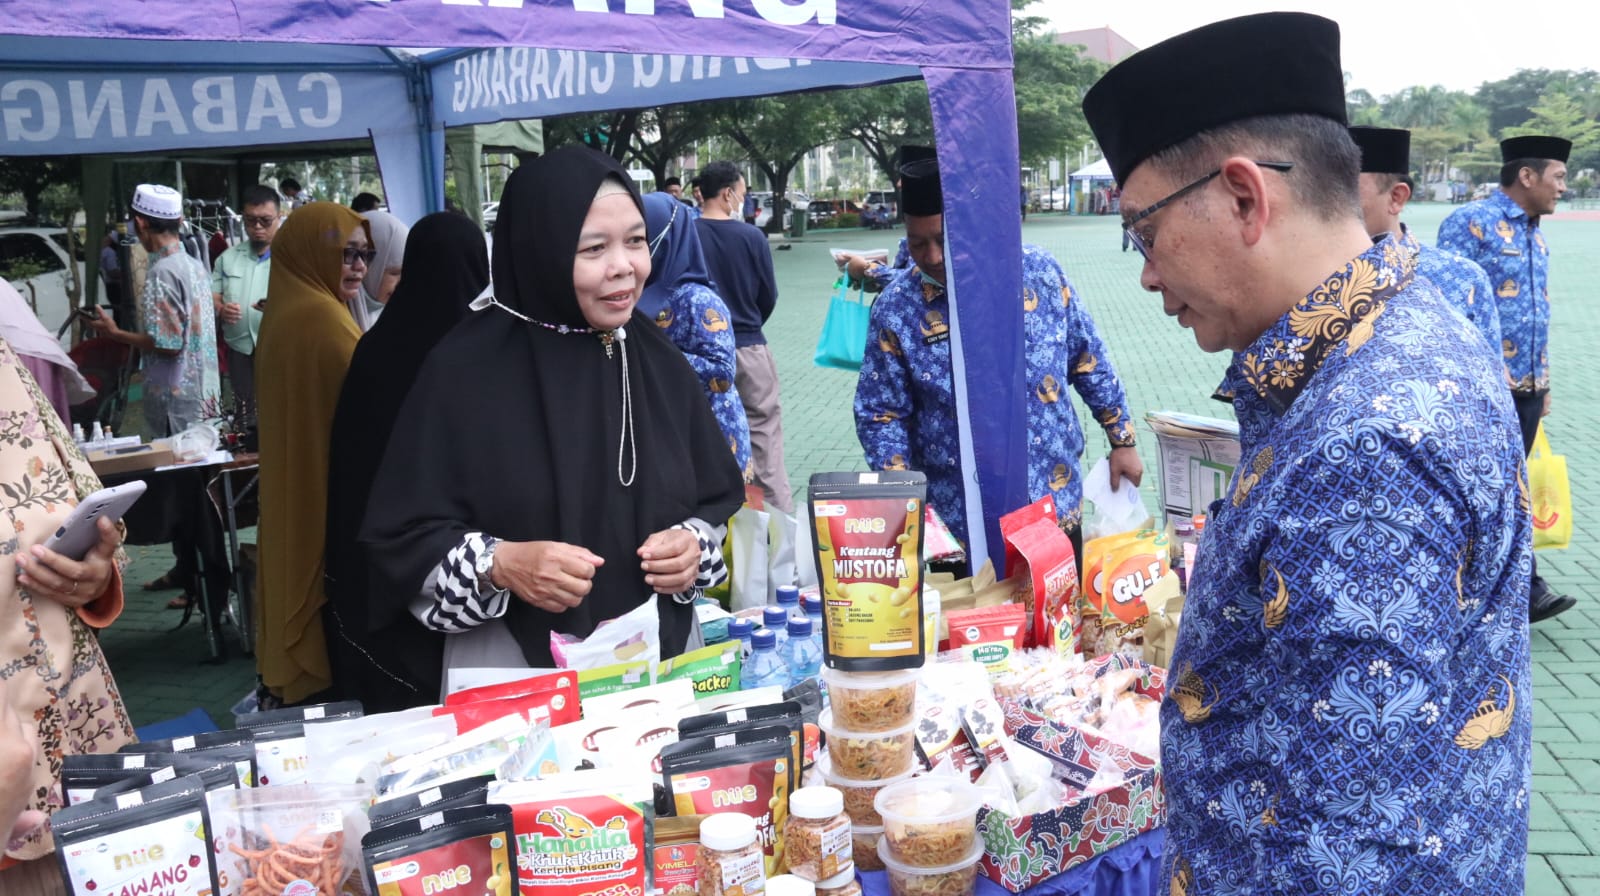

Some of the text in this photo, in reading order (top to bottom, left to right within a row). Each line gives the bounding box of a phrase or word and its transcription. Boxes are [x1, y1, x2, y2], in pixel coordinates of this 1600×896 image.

[840, 546, 896, 558] Kentang
[833, 559, 908, 578] MUSTOFA
[519, 829, 628, 854] Hanaila
[580, 861, 621, 872] Pisang
[422, 865, 471, 895] nüe
